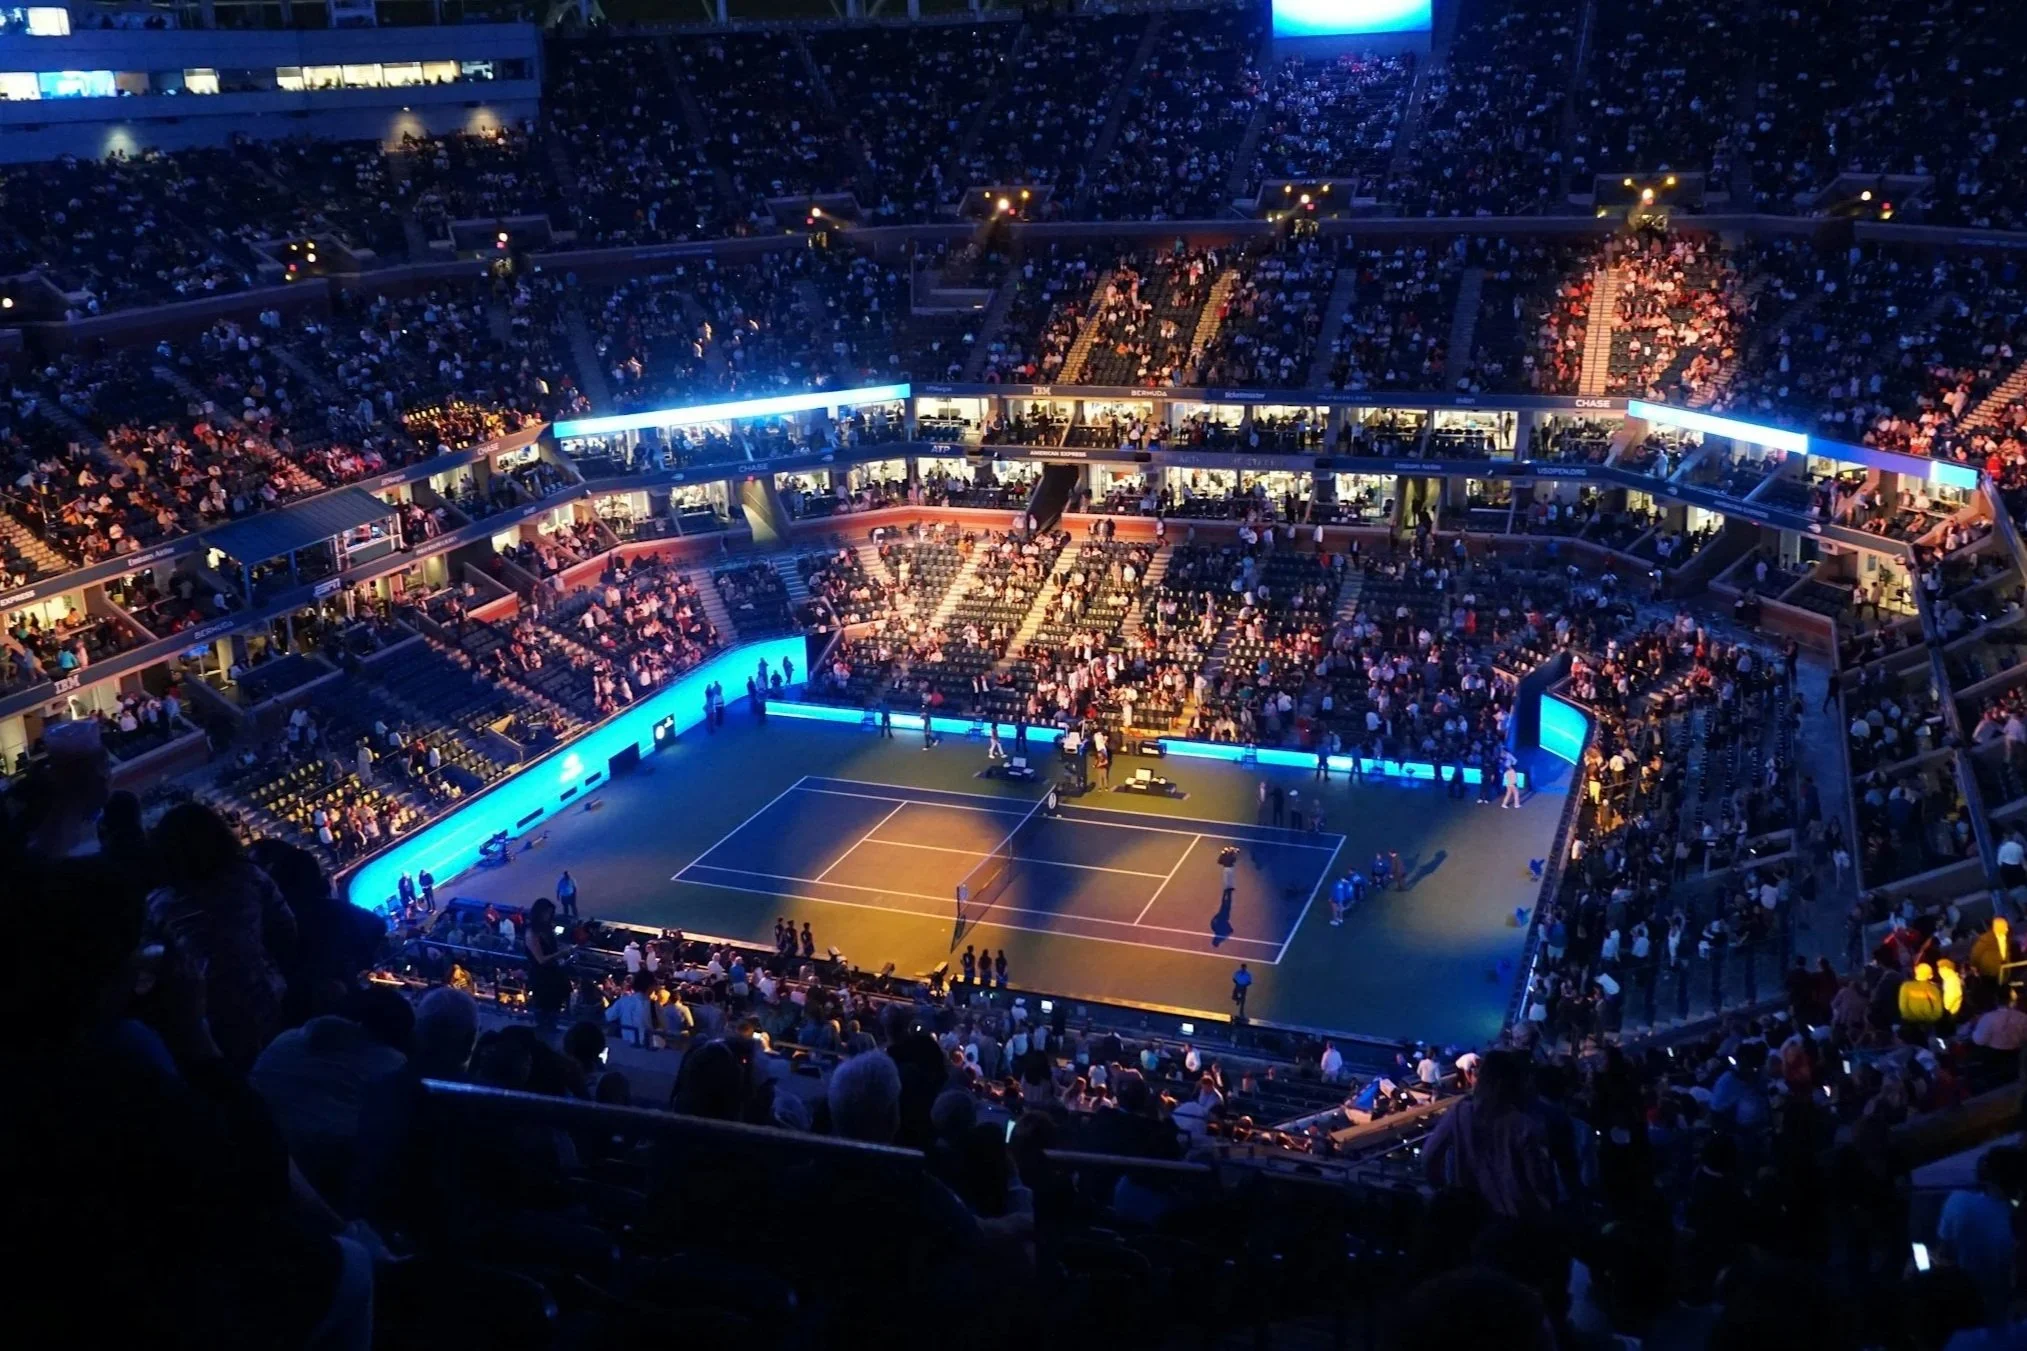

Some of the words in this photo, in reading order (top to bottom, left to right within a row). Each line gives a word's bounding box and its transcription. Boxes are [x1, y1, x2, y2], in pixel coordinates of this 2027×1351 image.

[1033, 386, 1051, 396] IBM
[1131, 389, 1168, 397] BERMUDA
[1575, 399, 1611, 408] CHASE
[477, 442, 500, 456] CHASE
[931, 445, 951, 454] ATP
[738, 463, 769, 473] CHASE
[314, 577, 341, 596] ESPN
[0, 590, 36, 607] EXPRESS
[194, 621, 235, 640] BERMUDA
[55, 674, 80, 695] IBM
